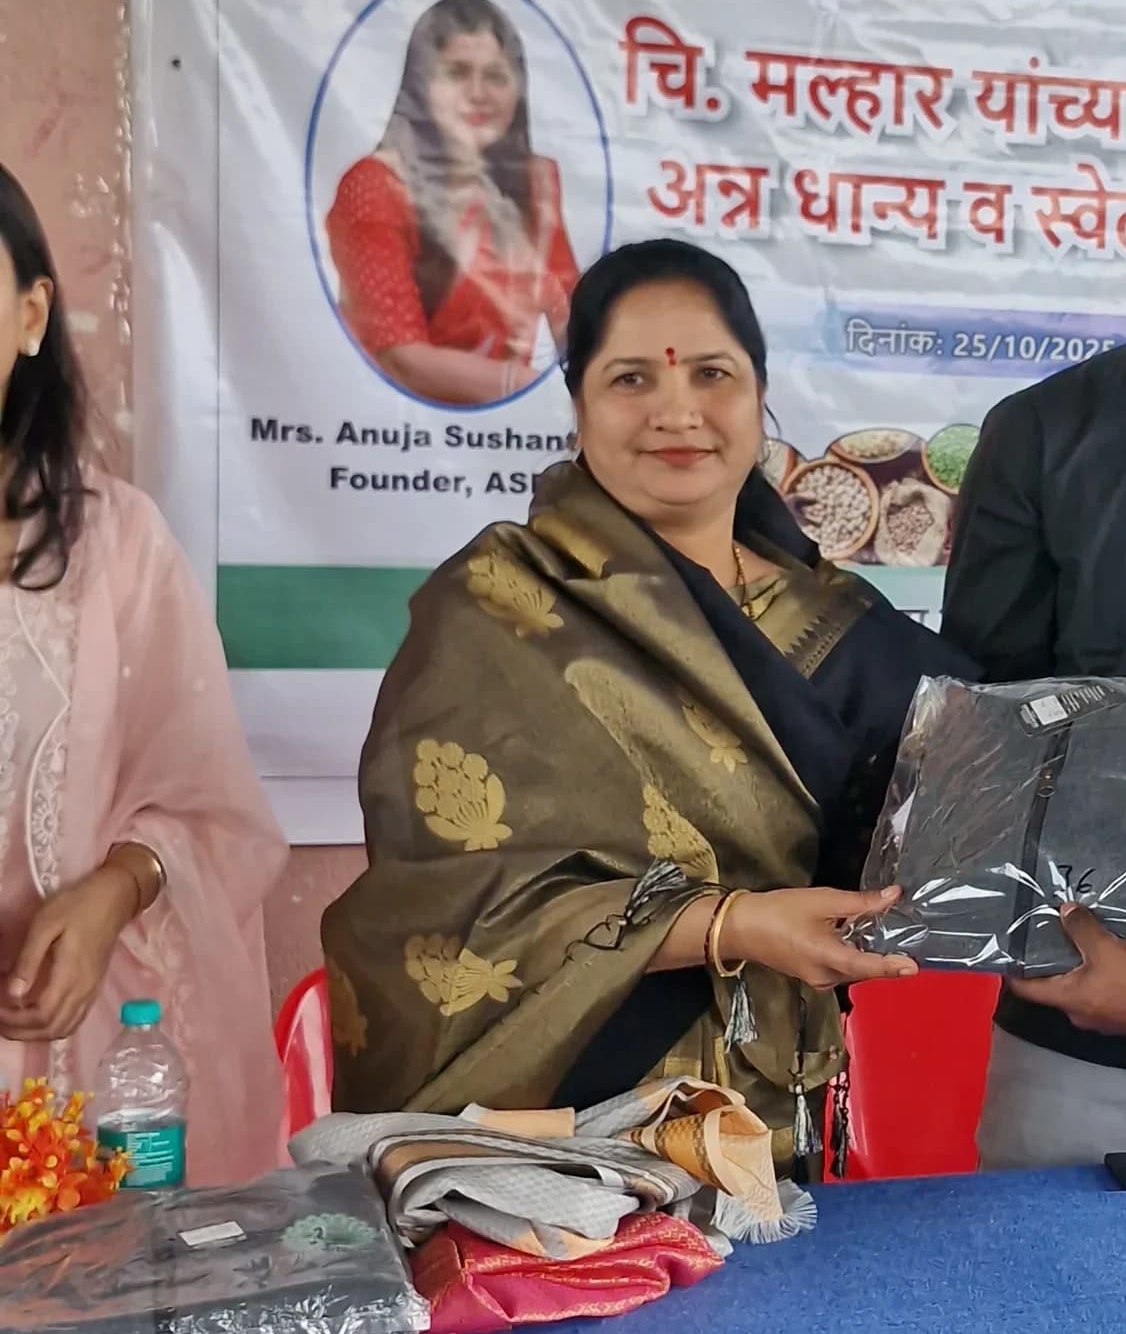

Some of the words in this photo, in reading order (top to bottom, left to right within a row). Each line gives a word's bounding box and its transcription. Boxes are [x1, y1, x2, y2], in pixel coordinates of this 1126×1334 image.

[619, 15, 722, 112] चि.
[745, 50, 953, 134] मल्हार
[647, 158, 768, 230] अन्न
[791, 167, 946, 240] धान्य
[962, 181, 1012, 244] व
[845, 317, 944, 356] दिनांक:
[250, 418, 324, 444] Mrs.
[336, 421, 432, 452] Anuja
[329, 466, 473, 498] Founder,
